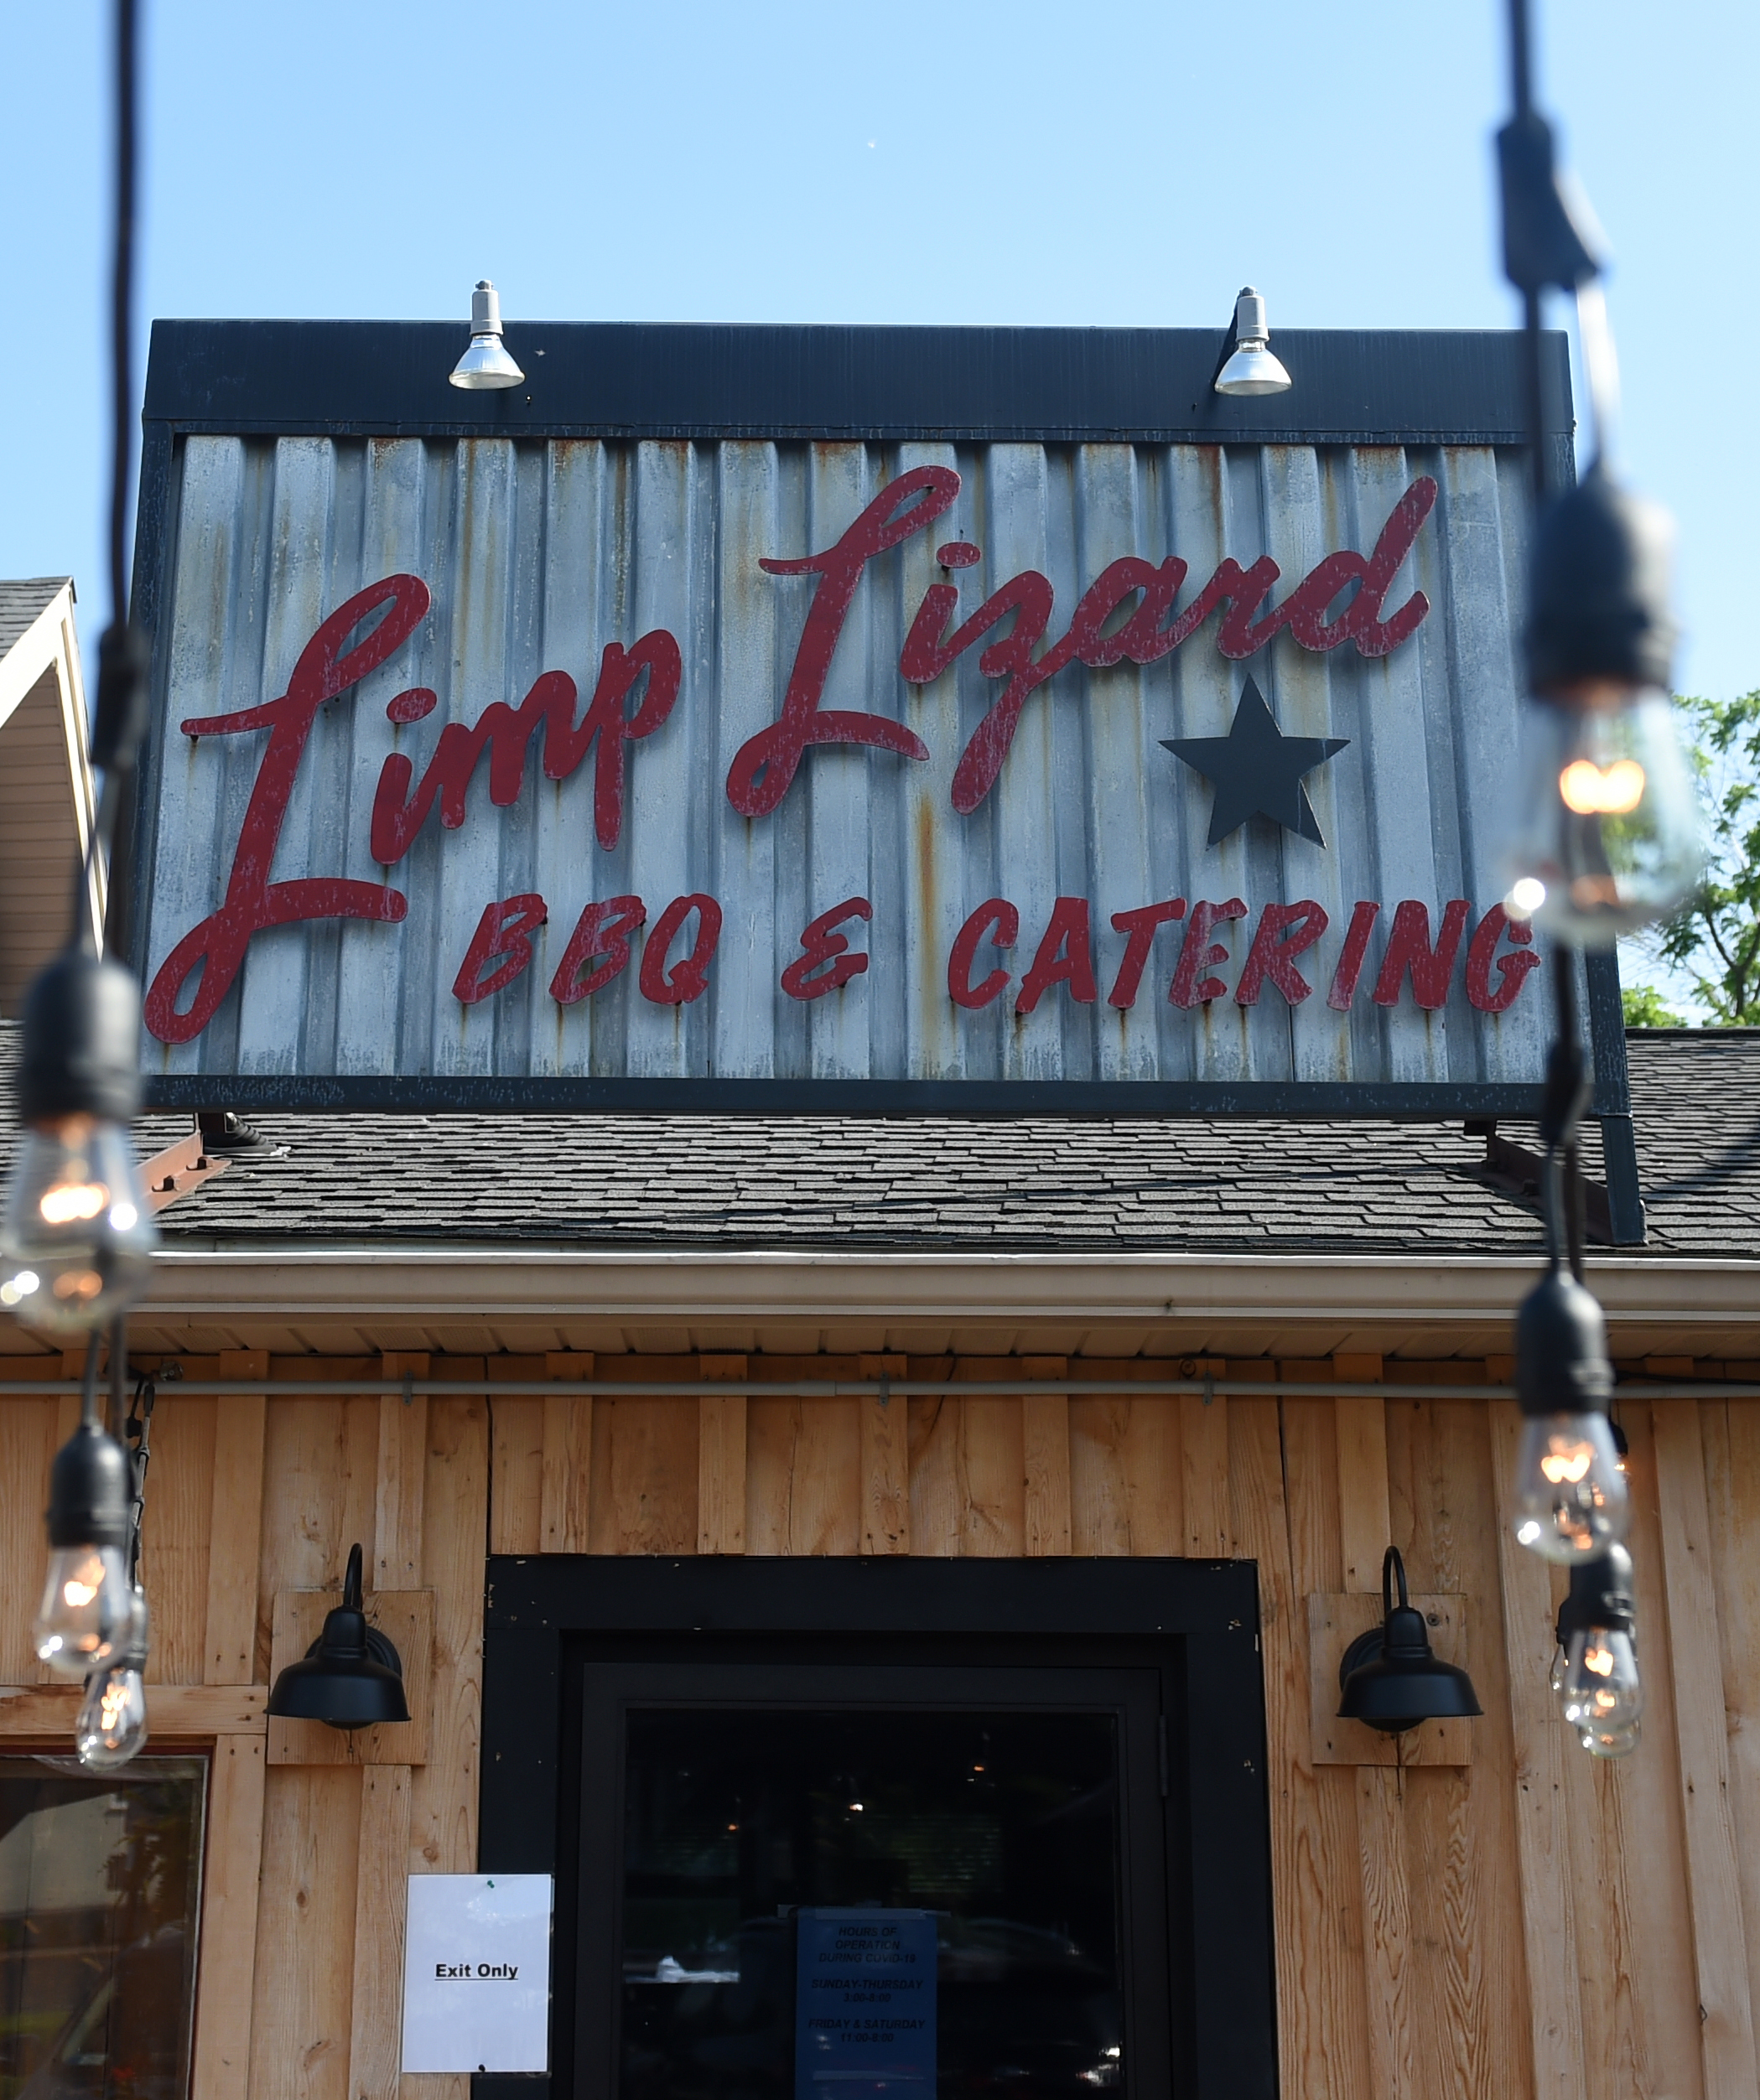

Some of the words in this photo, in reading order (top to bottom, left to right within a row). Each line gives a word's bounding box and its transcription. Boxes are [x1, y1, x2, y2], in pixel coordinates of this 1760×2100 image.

[144, 573, 682, 1044] Limp
[726, 465, 1436, 817] Lizard
[452, 893, 722, 1004] BBQ
[781, 897, 873, 1001] &
[948, 896, 1542, 1014] CATERING
[838, 1926, 879, 1937] HOURS
[881, 1926, 898, 1937] OF
[835, 1940, 901, 1950] OPERATION
[818, 1952, 862, 1963] DURING
[865, 1953, 916, 1963] COVID-19
[435, 1963, 471, 1977] Exit
[477, 1963, 518, 1980] Only
[812, 1979, 924, 1989] SUNDAY-THURSDAY
[808, 2019, 851, 2029] FRIDAY
[853, 2019, 861, 2029] &
[864, 2019, 926, 2030] SATURDAY
